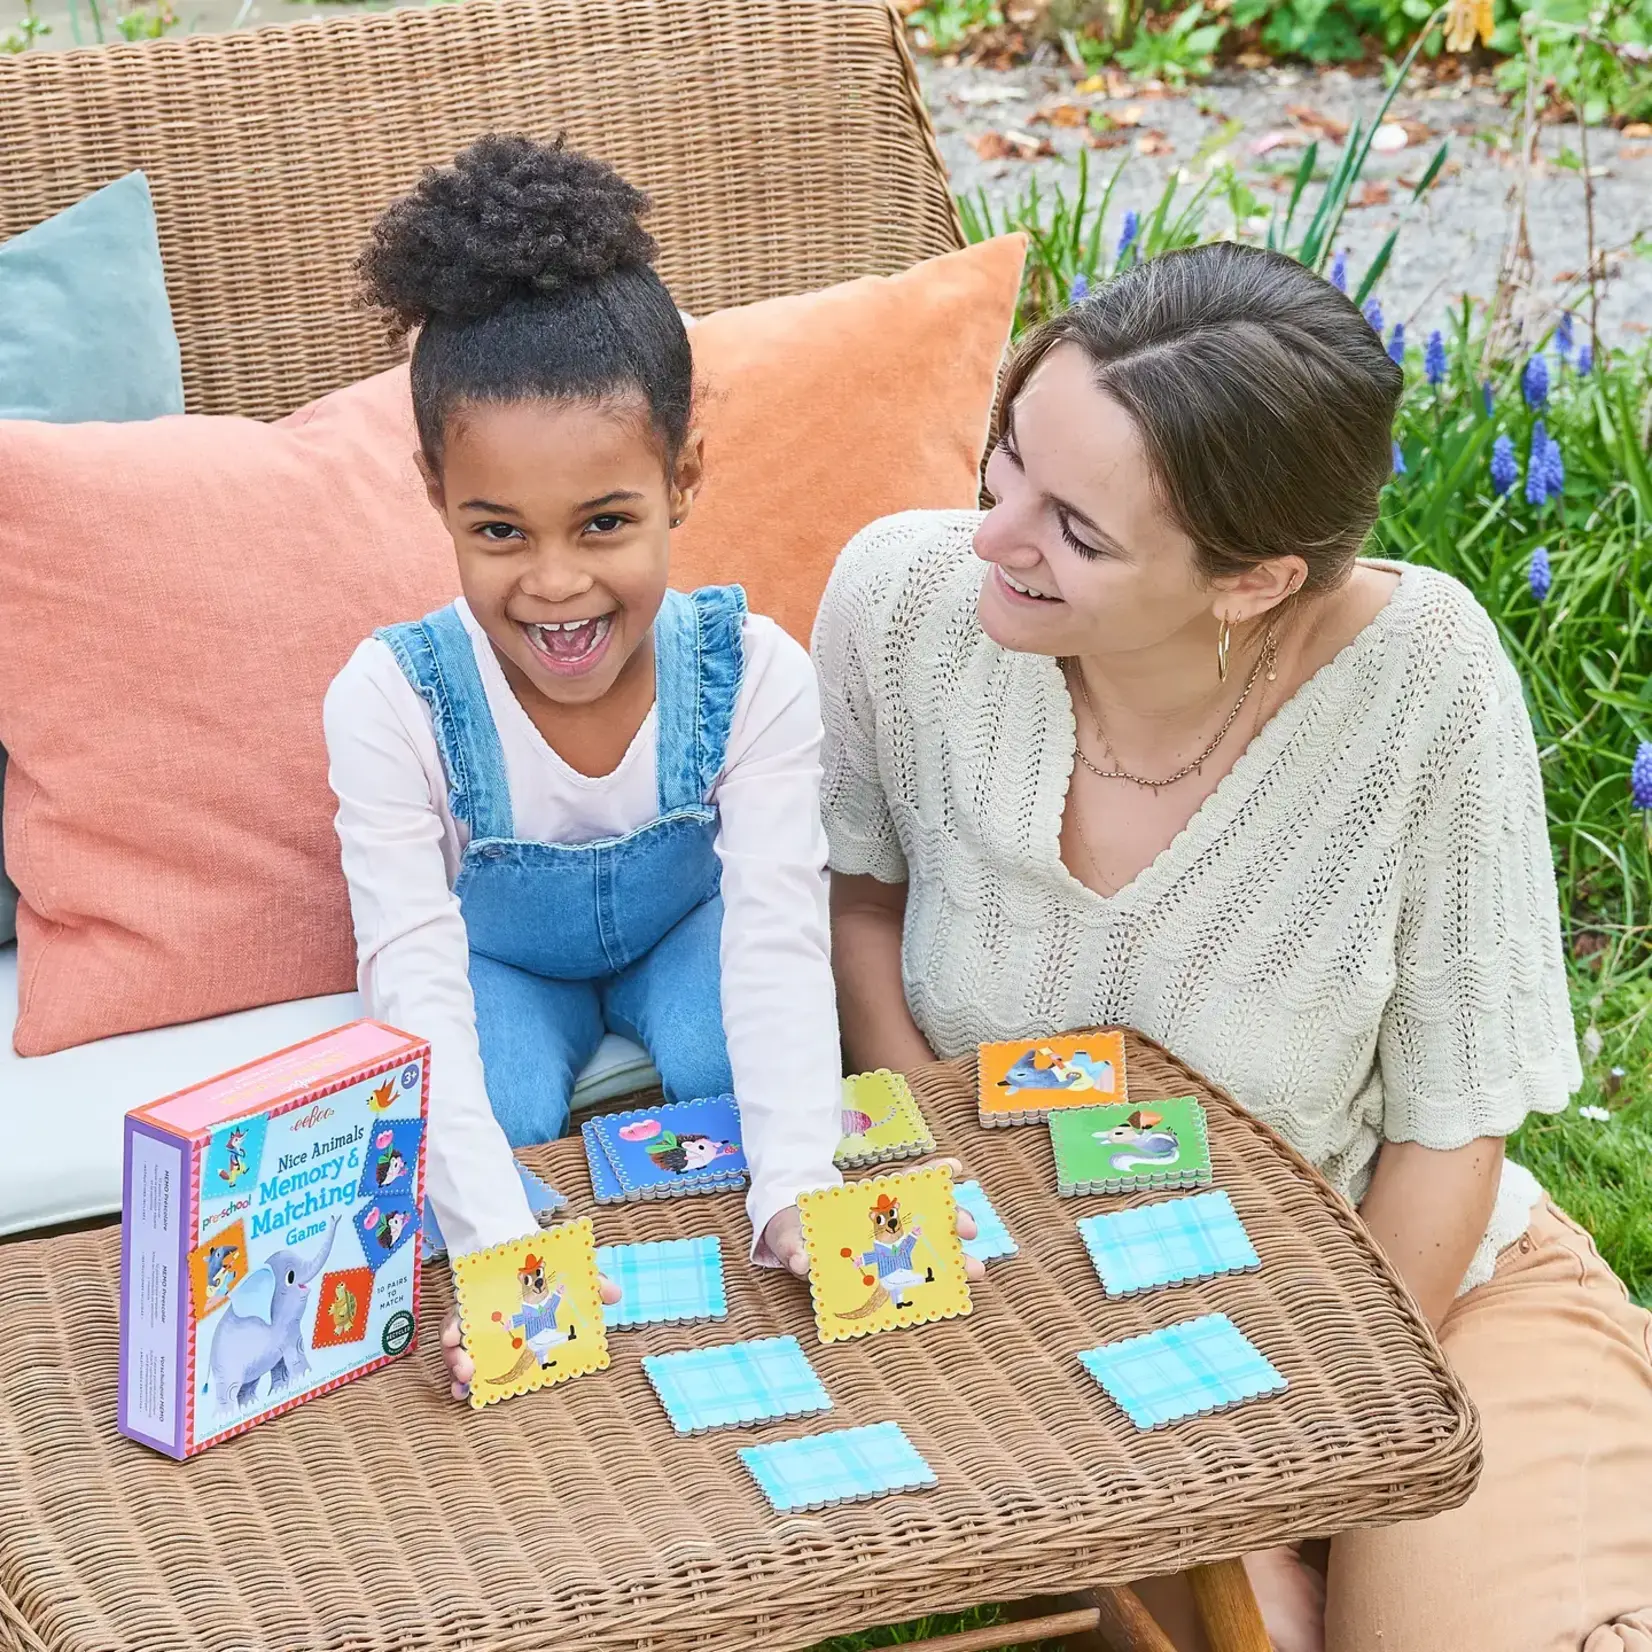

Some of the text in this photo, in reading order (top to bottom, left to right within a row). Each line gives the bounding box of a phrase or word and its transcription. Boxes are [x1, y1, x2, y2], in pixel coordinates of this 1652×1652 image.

[404, 1071, 417, 1084] 3+
[278, 1125, 364, 1174] Nice Animals
[259, 1147, 359, 1206] Memory &
[203, 1194, 251, 1231] pre-school
[250, 1179, 357, 1239] Matching
[286, 1220, 327, 1246] Game
[387, 1276, 408, 1290] PAIRS
[388, 1290, 397, 1298] TO
[380, 1295, 404, 1310] MATCH
